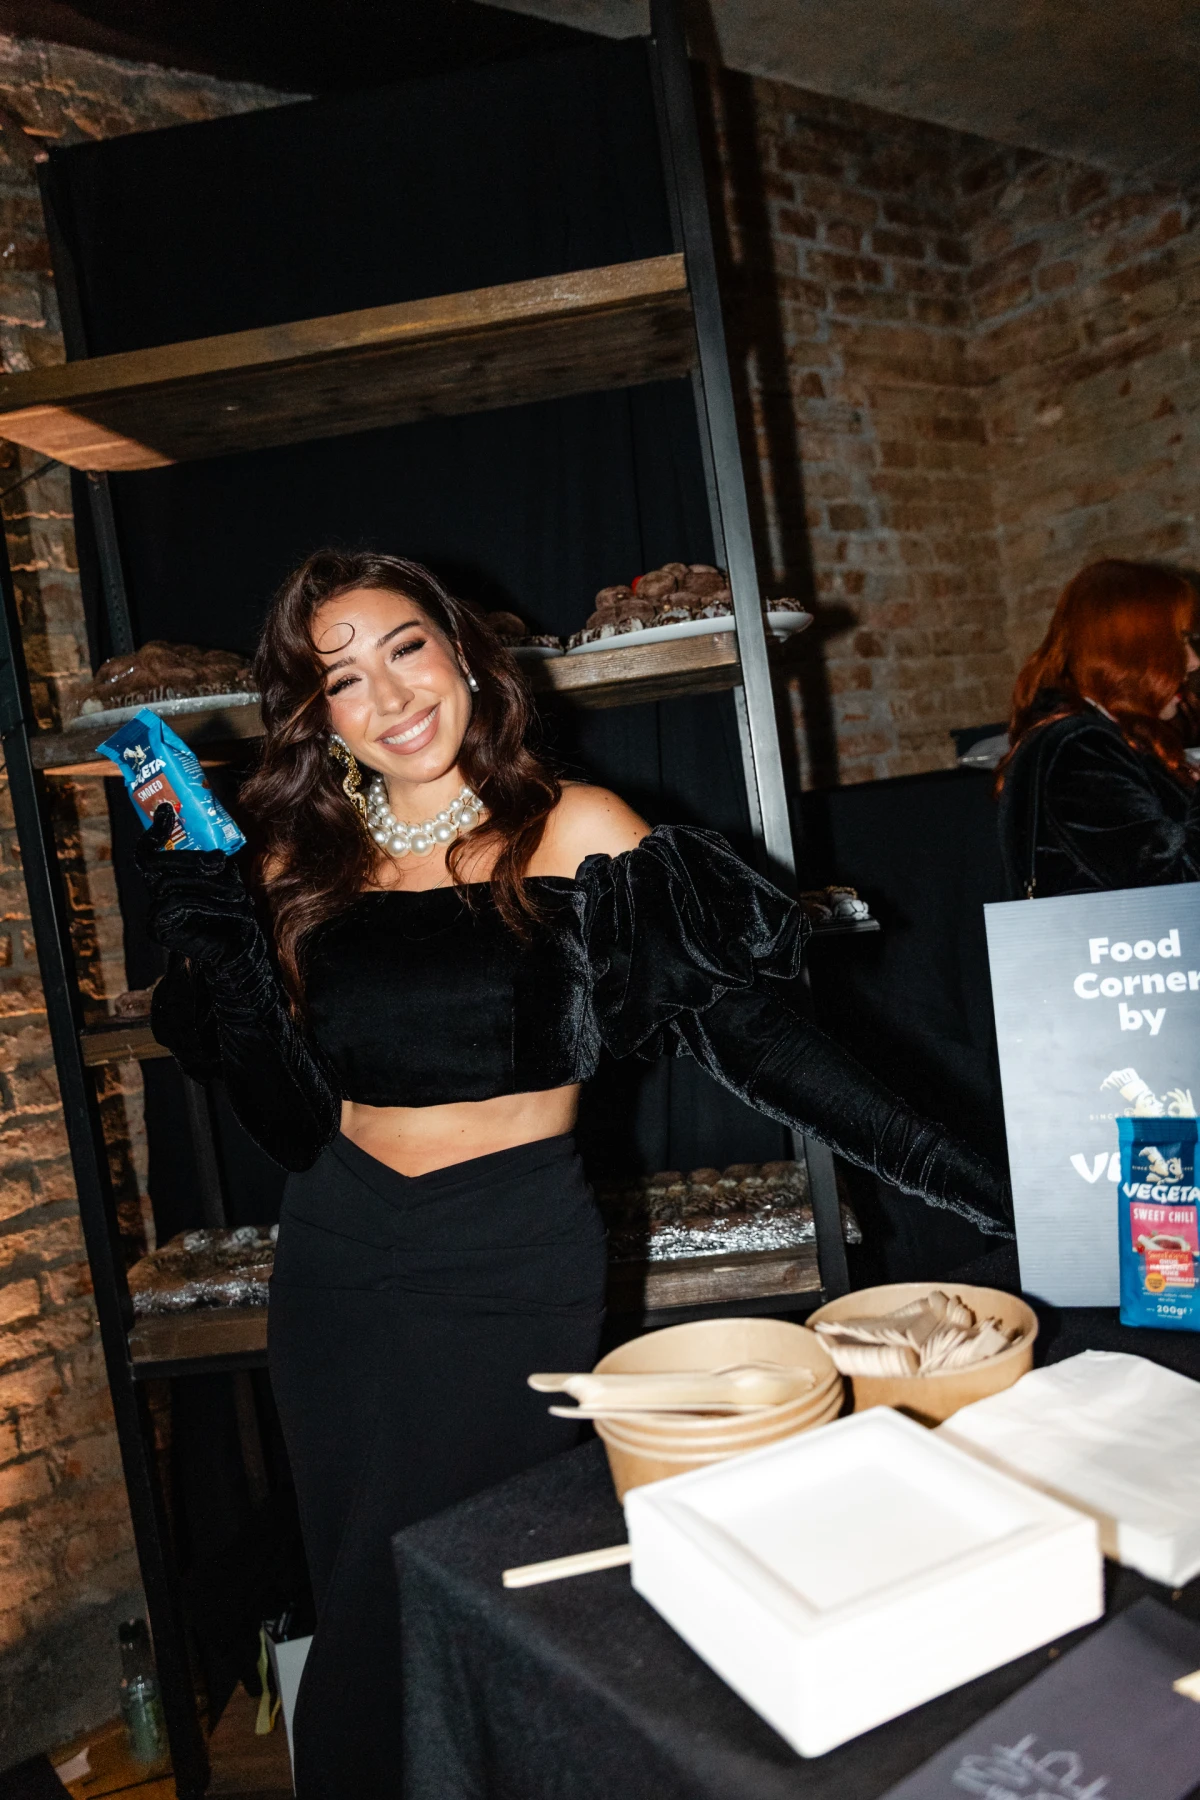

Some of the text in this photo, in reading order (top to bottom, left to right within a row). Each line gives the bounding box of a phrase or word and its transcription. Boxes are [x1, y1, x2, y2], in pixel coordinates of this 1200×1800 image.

[137, 780, 163, 802] SMOKED
[1088, 929, 1181, 965] Food
[1073, 970, 1200, 1000] Corner
[1118, 1002, 1167, 1036] by
[1122, 1182, 1200, 1204] VEGETA
[1133, 1208, 1195, 1223] SWEET CHILI
